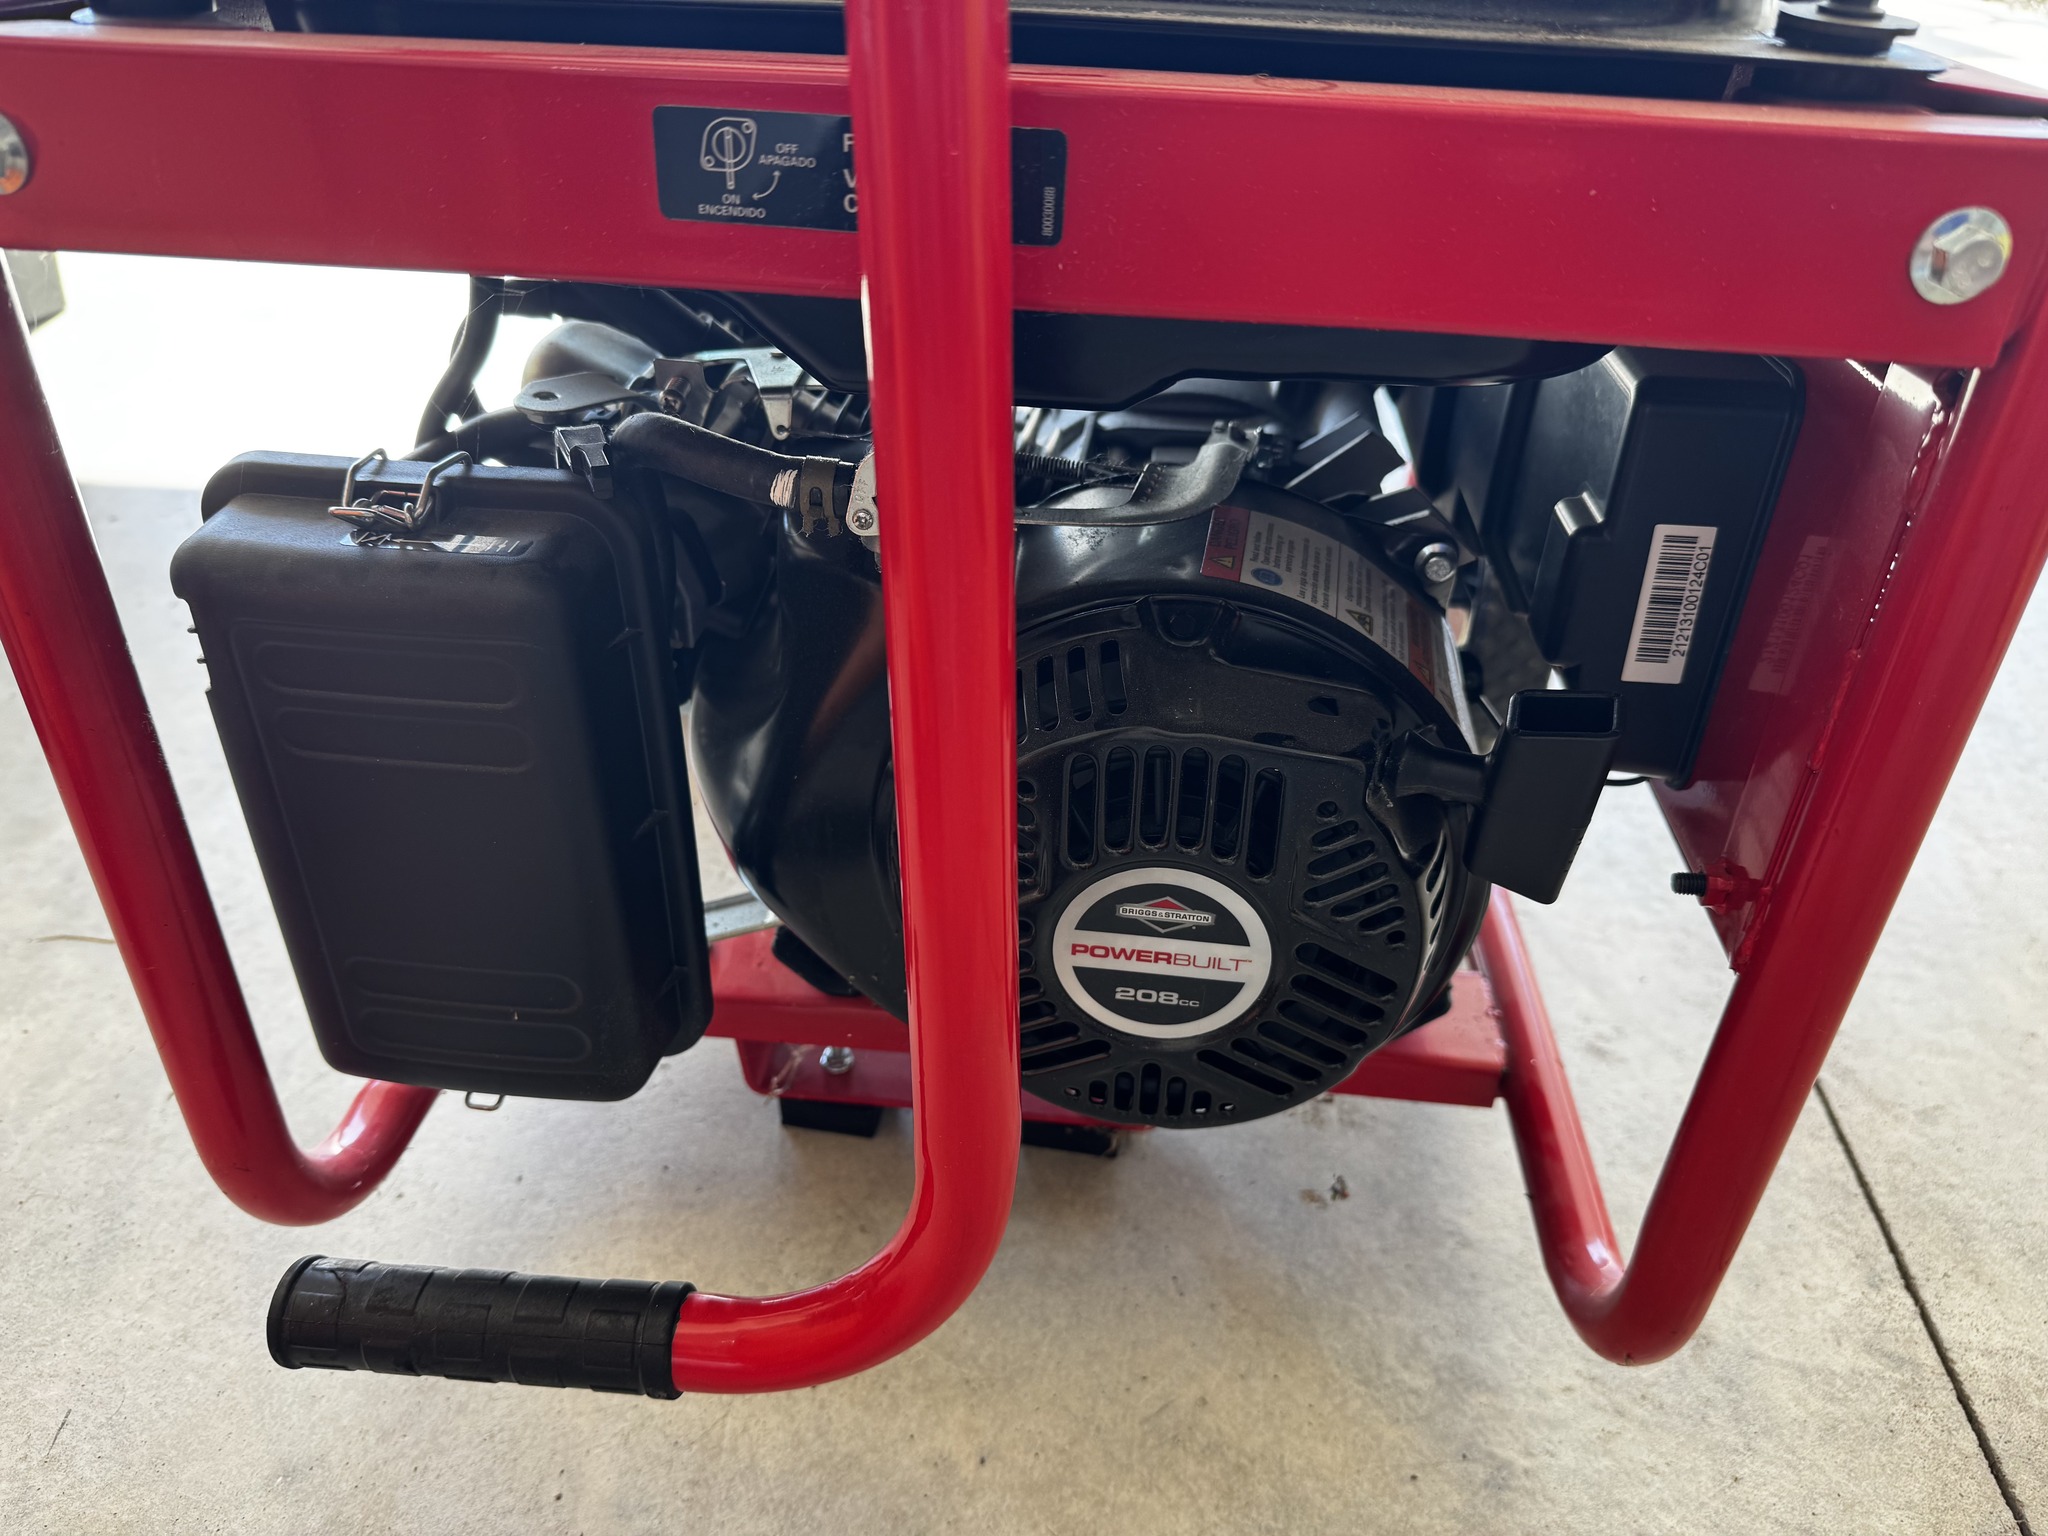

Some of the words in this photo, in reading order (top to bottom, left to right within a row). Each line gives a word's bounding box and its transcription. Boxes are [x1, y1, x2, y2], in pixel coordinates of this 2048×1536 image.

[775, 143, 799, 154] OFF
[758, 154, 816, 169] APAGADO
[721, 193, 741, 205] ON
[698, 203, 766, 219] ENCENDIDO
[1672, 547, 1711, 658] 21213100124C01
